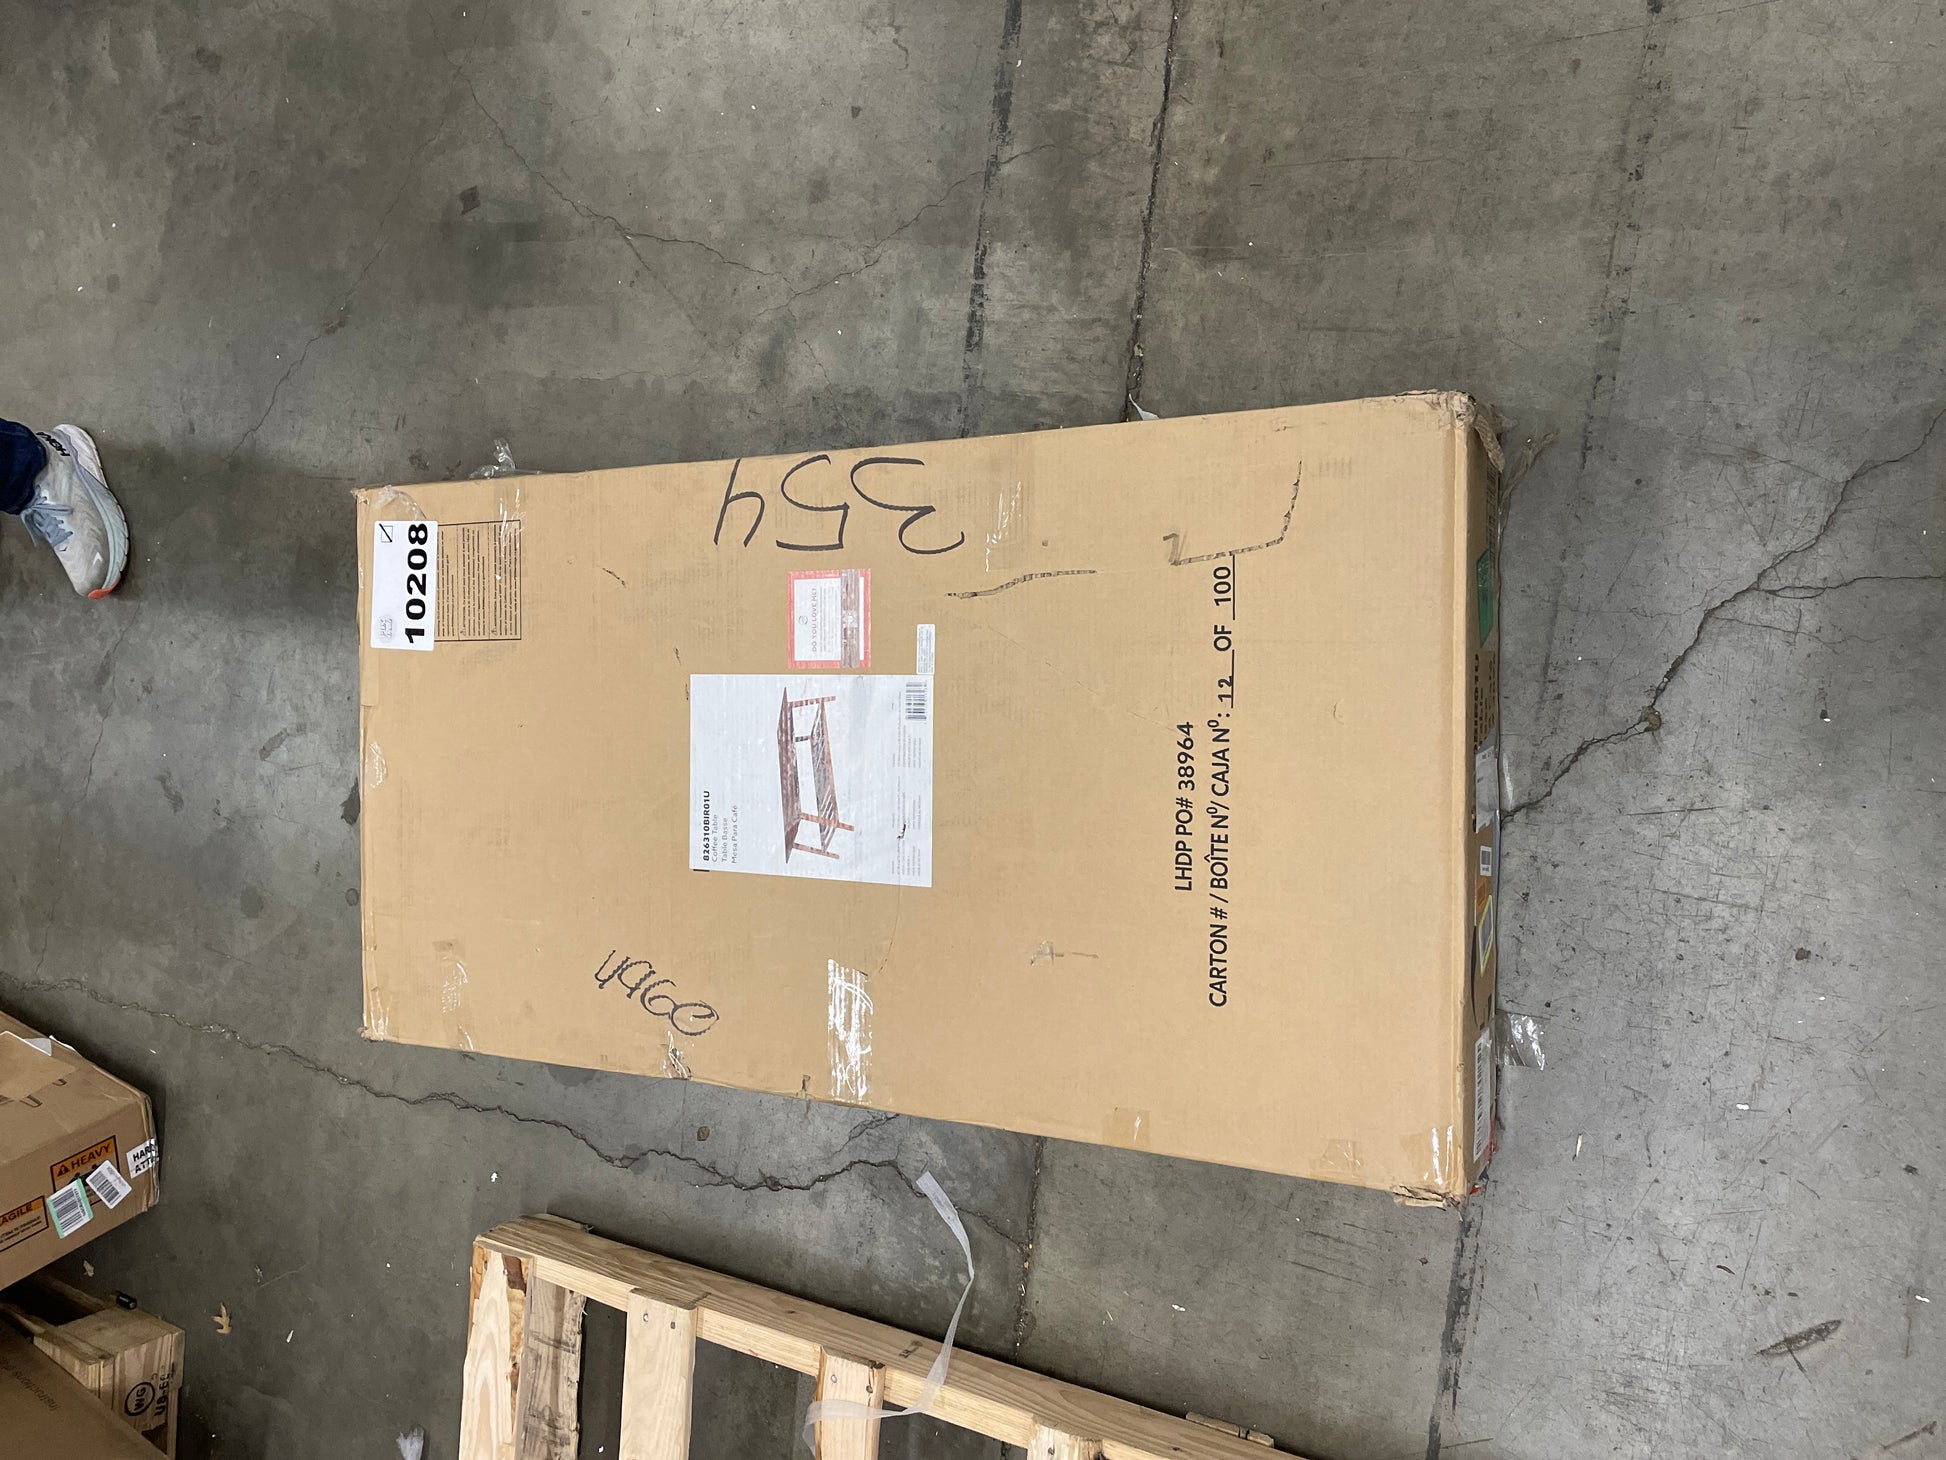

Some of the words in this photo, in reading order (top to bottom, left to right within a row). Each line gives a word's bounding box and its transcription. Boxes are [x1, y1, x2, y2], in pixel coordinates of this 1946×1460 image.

[713, 455, 965, 555] 354
[405, 522, 428, 645] 10208
[1212, 566, 1231, 606] 100
[1213, 624, 1231, 652] OF
[1217, 675, 1233, 703] 12
[1175, 722, 1195, 791] 38964
[1209, 747, 1231, 797] CAJA
[702, 790, 711, 862] 826310BIR01U
[711, 814, 719, 835] Table
[730, 805, 739, 823] Café
[1174, 797, 1193, 836] PO#
[720, 817, 729, 840] Basse
[730, 824, 739, 842] Para
[711, 836, 719, 863] Coffee
[720, 841, 729, 863] Table
[730, 843, 739, 864] Mesa
[1204, 832, 1231, 889] BOÎTE
[1174, 840, 1193, 891] LHDP
[1208, 906, 1229, 920] #
[1208, 924, 1230, 1007] CARTON
[70, 1143, 112, 1170] HEAVY
